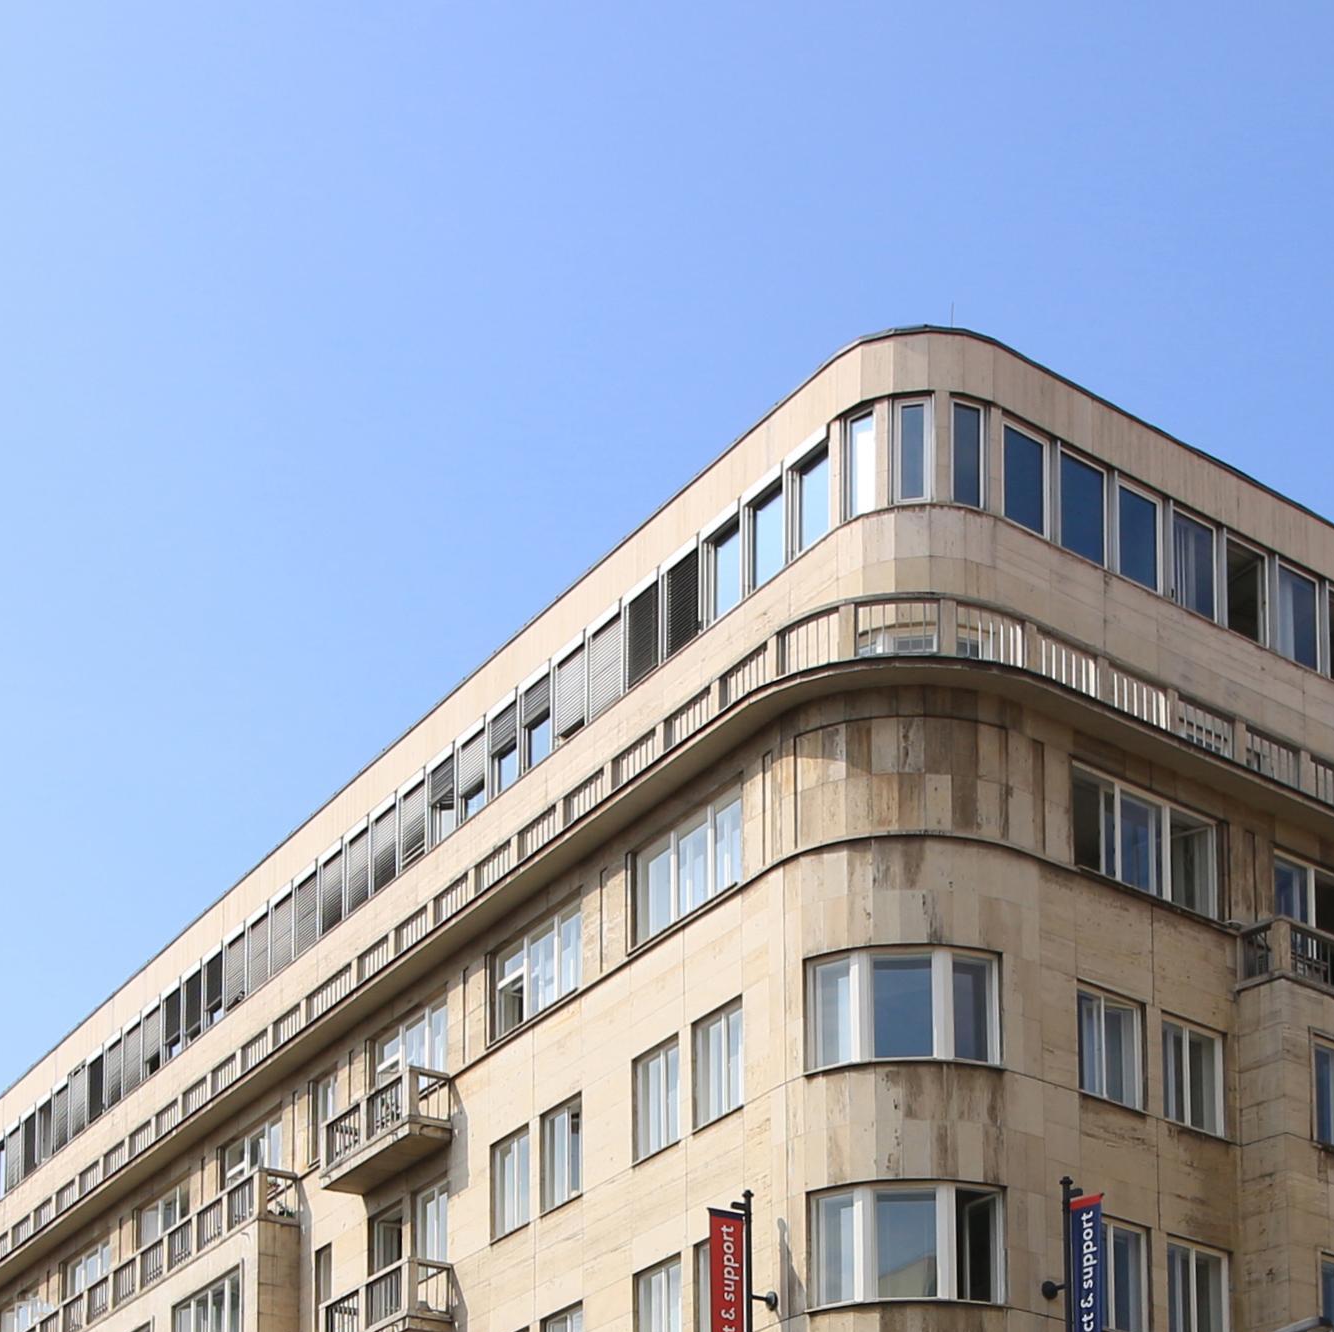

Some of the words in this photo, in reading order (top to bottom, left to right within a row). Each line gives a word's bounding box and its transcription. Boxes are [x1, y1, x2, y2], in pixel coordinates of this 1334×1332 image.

[721, 1224, 739, 1303] support
[1080, 1210, 1097, 1289] support
[720, 1307, 735, 1321] &
[1080, 1293, 1093, 1308] &
